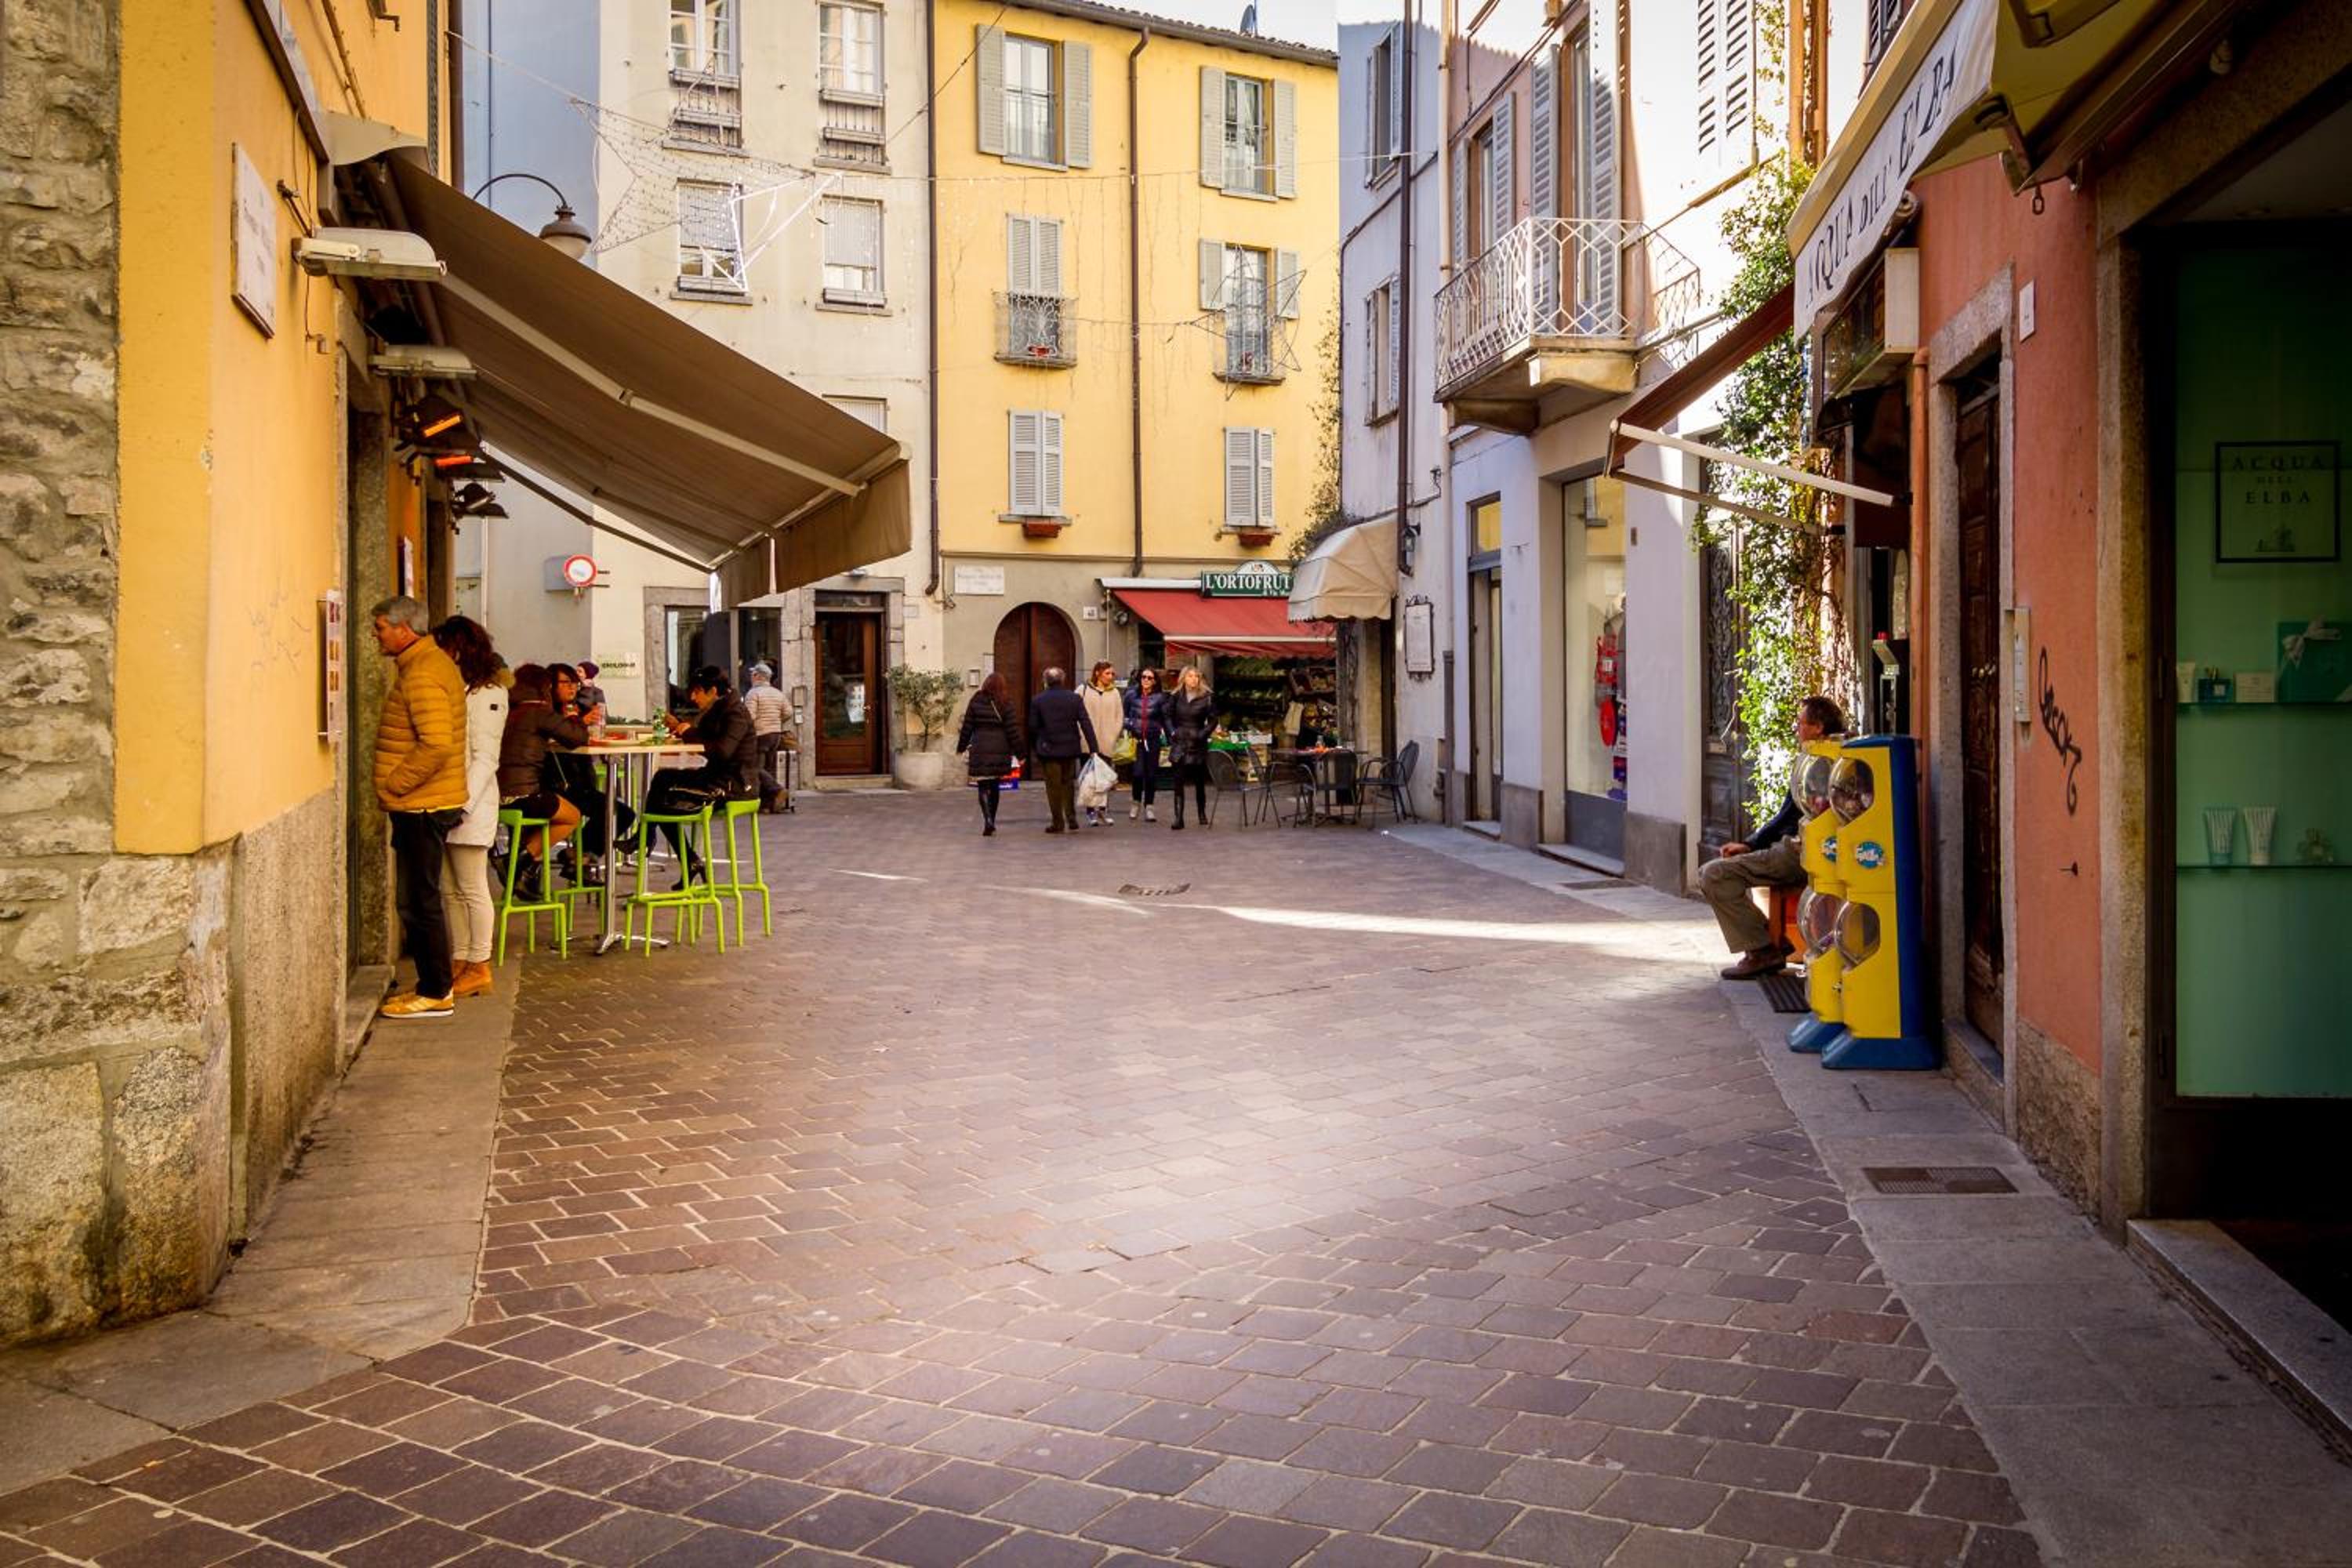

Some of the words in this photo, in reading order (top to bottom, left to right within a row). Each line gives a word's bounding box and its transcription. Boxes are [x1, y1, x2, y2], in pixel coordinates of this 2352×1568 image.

[1806, 194, 1853, 308] ACQUA
[1897, 33, 1960, 180] ELBA
[2233, 455, 2325, 471] ACQUA
[2245, 488, 2310, 503] ELBA
